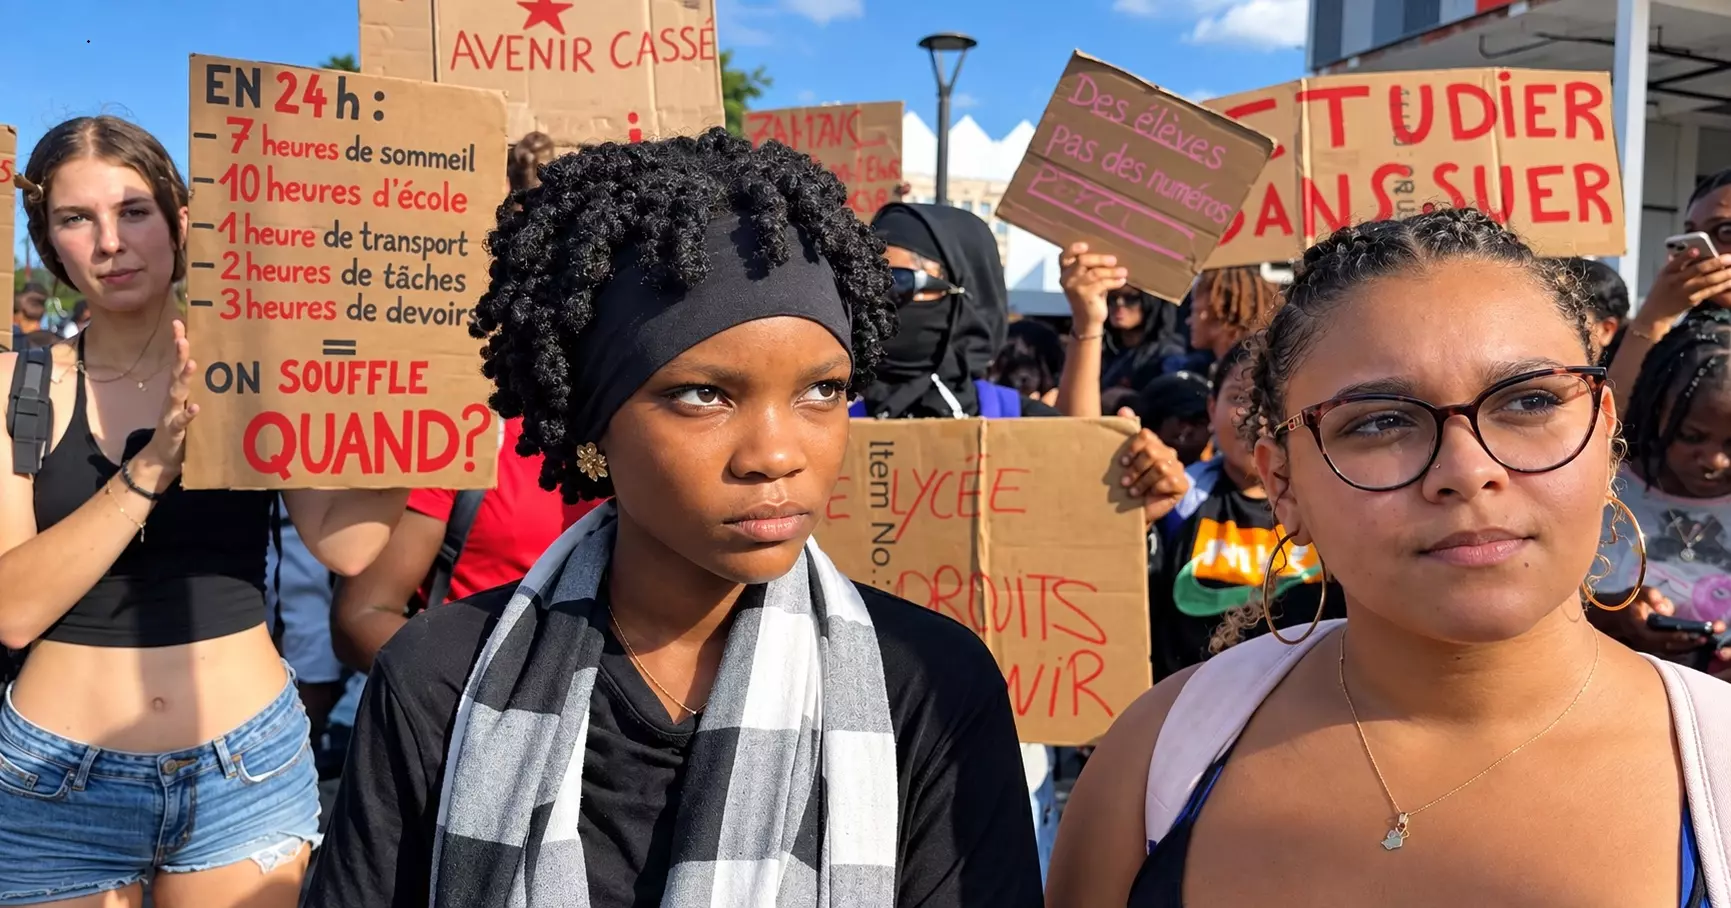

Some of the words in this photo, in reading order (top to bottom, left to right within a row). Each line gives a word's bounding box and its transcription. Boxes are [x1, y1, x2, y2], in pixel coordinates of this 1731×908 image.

[450, 30, 595, 73] AVENIR
[609, 18, 716, 69] CASSÉ
[206, 64, 261, 108] EN
[226, 116, 254, 154] 7
[262, 123, 339, 160] heures
[345, 134, 373, 163] de
[380, 143, 475, 172] sommeil
[1067, 72, 1130, 124] Des
[1133, 104, 1226, 170] élèves
[218, 163, 260, 202] 10
[267, 165, 361, 206] heures
[372, 178, 468, 213] d'école
[1044, 124, 1099, 164] pas
[1101, 143, 1147, 183] des
[1147, 168, 1232, 225] numéros
[217, 212, 237, 244] 1
[244, 213, 316, 247] heure
[323, 219, 353, 248] de
[359, 221, 468, 260] transport
[220, 251, 241, 280] 2
[246, 251, 331, 284] heures
[341, 257, 372, 286] de
[219, 288, 241, 320] 3
[246, 289, 337, 321] heures
[346, 293, 377, 322] de
[386, 295, 478, 326] devoirs
[205, 361, 260, 394] ON
[278, 359, 429, 395] SOUFFLE
[242, 403, 492, 481] QUAND?
[868, 440, 895, 510] Item
